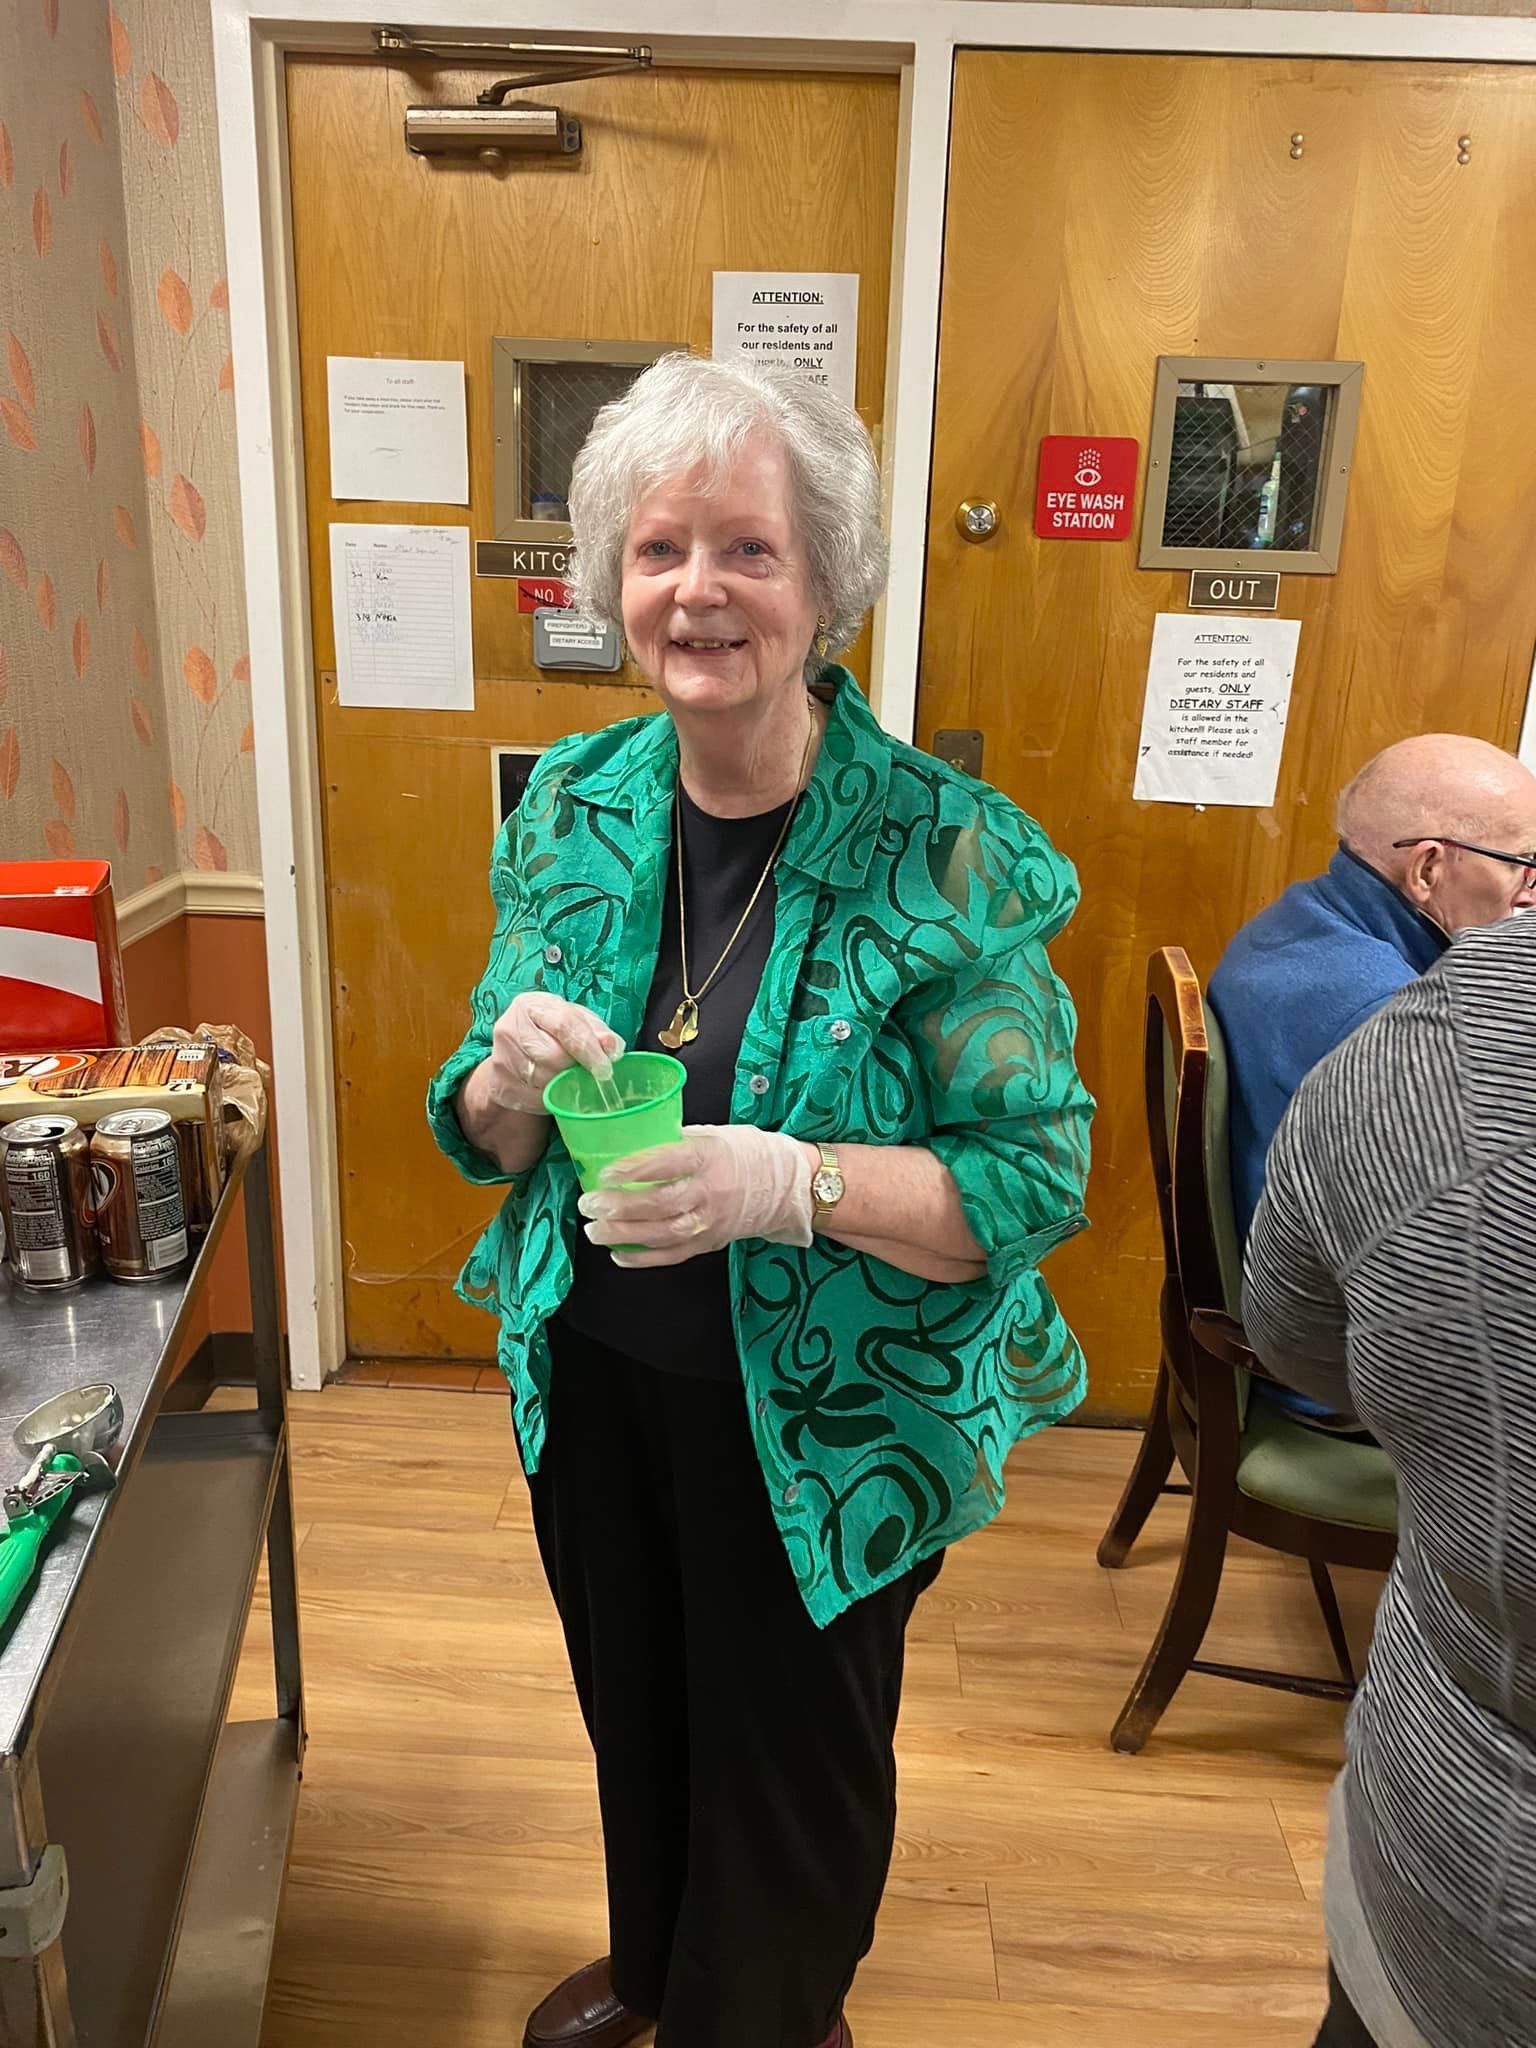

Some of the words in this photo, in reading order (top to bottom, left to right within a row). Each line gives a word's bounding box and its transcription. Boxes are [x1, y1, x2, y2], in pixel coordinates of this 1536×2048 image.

[752, 291, 824, 304] ATTENTION:
[738, 322, 755, 333] For
[758, 323, 775, 333] the
[777, 323, 809, 335] safety
[812, 324, 823, 333] of
[825, 324, 838, 334] all
[741, 342, 759, 350] our
[762, 340, 810, 351] residents
[813, 341, 833, 351] and
[793, 357, 823, 369] ONLY
[1047, 492, 1076, 508] EYE
[1081, 494, 1124, 510] WASH
[1052, 512, 1115, 529] STATION
[513, 551, 566, 572] KITC
[534, 588, 554, 603] NO
[1209, 579, 1261, 600] OUT
[1177, 658, 1192, 666] For
[1196, 658, 1209, 666] the
[1212, 658, 1239, 668] safety
[1242, 658, 1251, 666] of
[1254, 658, 1264, 666] all
[1185, 686, 1215, 695] guests,
[1218, 684, 1251, 695] ONLY
[1169, 699, 1222, 711] DIETARY
[1226, 699, 1264, 712] STAFF
[1192, 714, 1221, 722] allowed
[1208, 726, 1232, 734] Please
[1176, 737, 1197, 745] staff
[1200, 738, 1232, 746] member
[1235, 738, 1248, 746] for
[1168, 749, 1209, 757] assistance
[32, 1171, 51, 1180] 160
